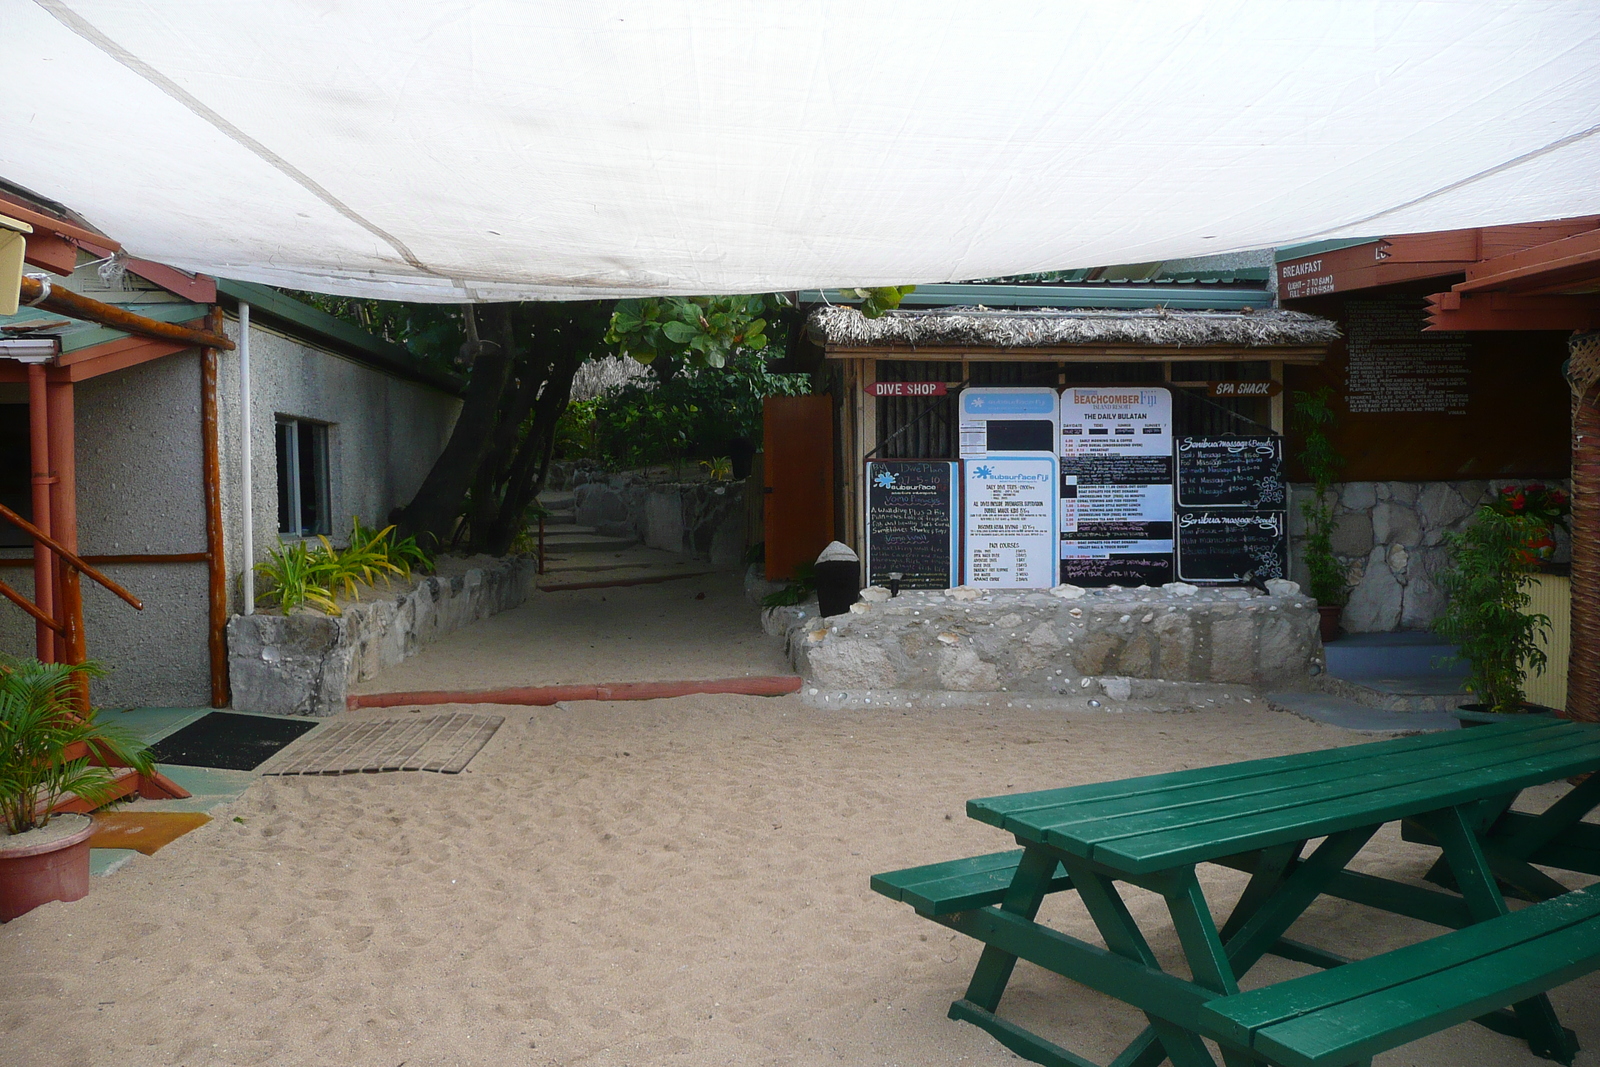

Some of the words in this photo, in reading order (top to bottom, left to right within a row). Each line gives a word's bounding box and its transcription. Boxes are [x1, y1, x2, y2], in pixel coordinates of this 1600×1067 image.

[1375, 246, 1390, 260] LU
[1283, 260, 1322, 278] BREAKFAST
[1311, 278, 1318, 286] TO
[1290, 290, 1300, 298] FULL
[1311, 287, 1318, 295] TO
[876, 383, 903, 395] DIVE
[907, 383, 937, 395] SHOP
[1216, 382, 1235, 395] SPA
[1237, 382, 1271, 394] SHACK
[1074, 391, 1139, 404] BEACHCOMBER
[1140, 391, 1157, 408] Fiji
[1219, 440, 1248, 452] massage
[1252, 437, 1275, 455] Beauty
[1253, 513, 1278, 532] Beauty
